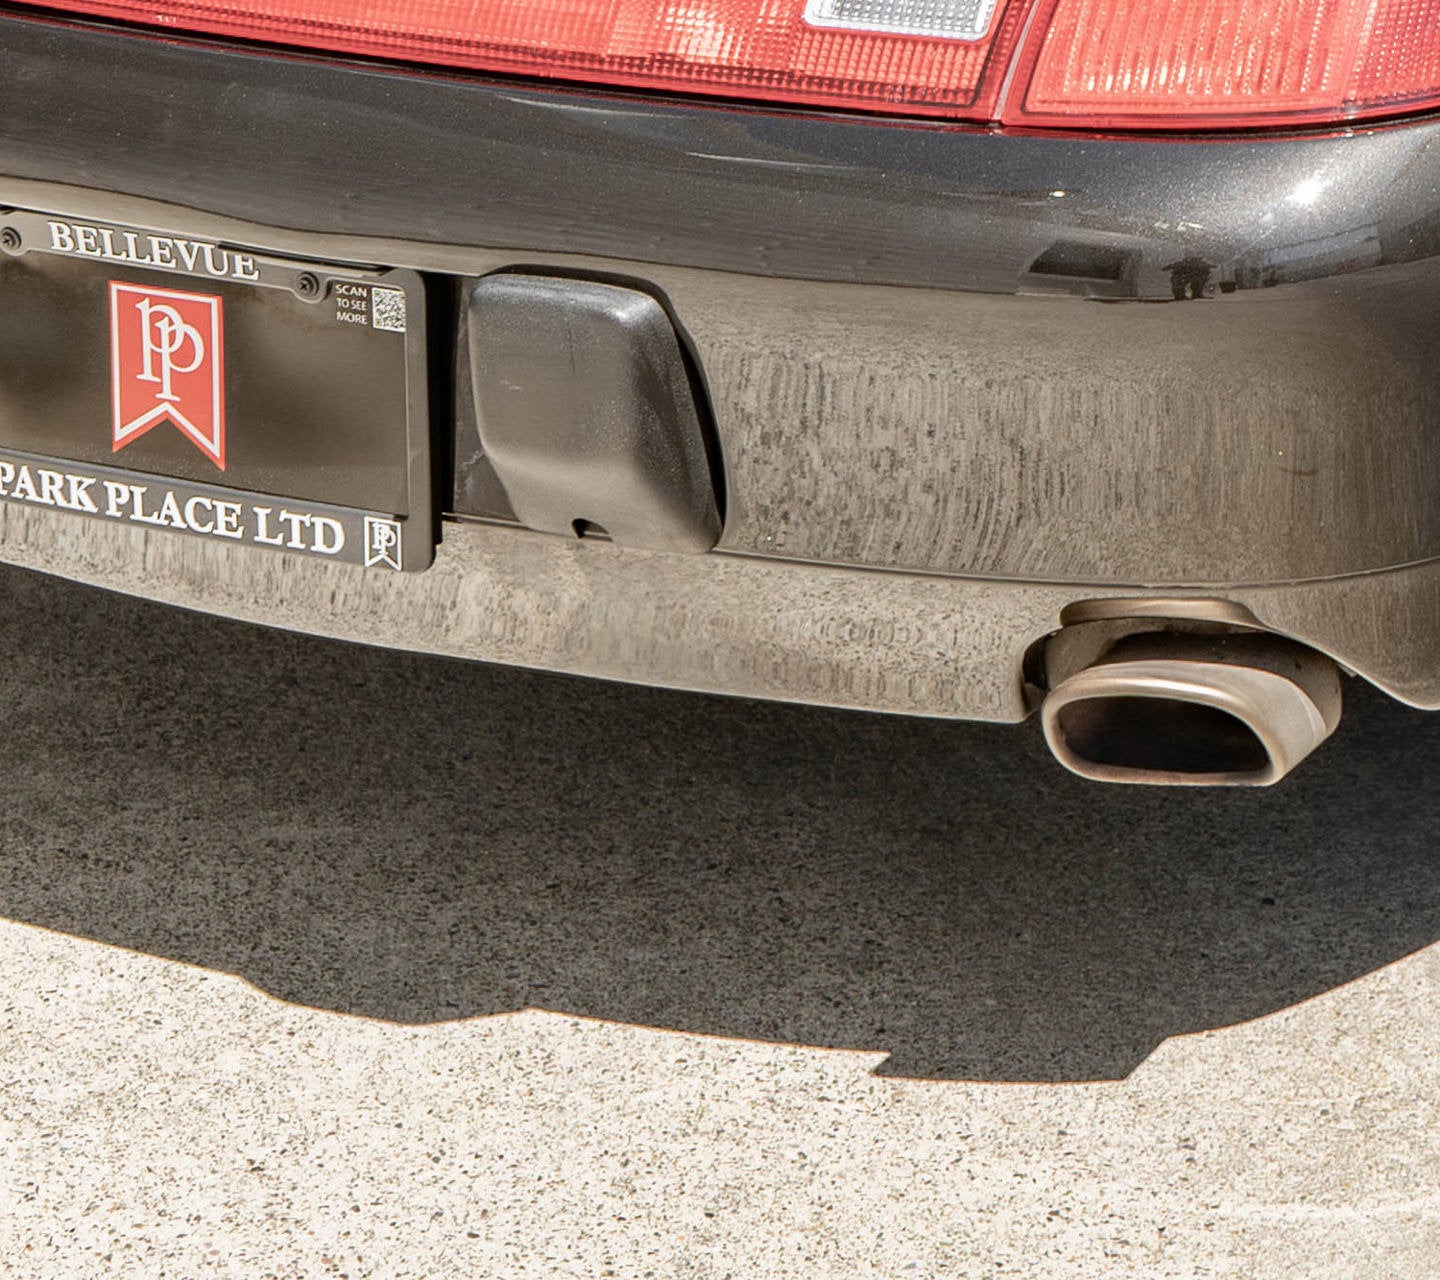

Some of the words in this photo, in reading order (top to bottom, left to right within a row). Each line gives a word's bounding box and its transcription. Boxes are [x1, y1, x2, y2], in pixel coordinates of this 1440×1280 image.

[47, 220, 260, 281] BELLEVUE
[335, 283, 368, 298] SCAN
[336, 297, 350, 309] TO
[351, 300, 368, 311] SEE
[336, 311, 368, 326] MORE
[103, 480, 245, 540] PLACE
[253, 506, 346, 555] LTD
